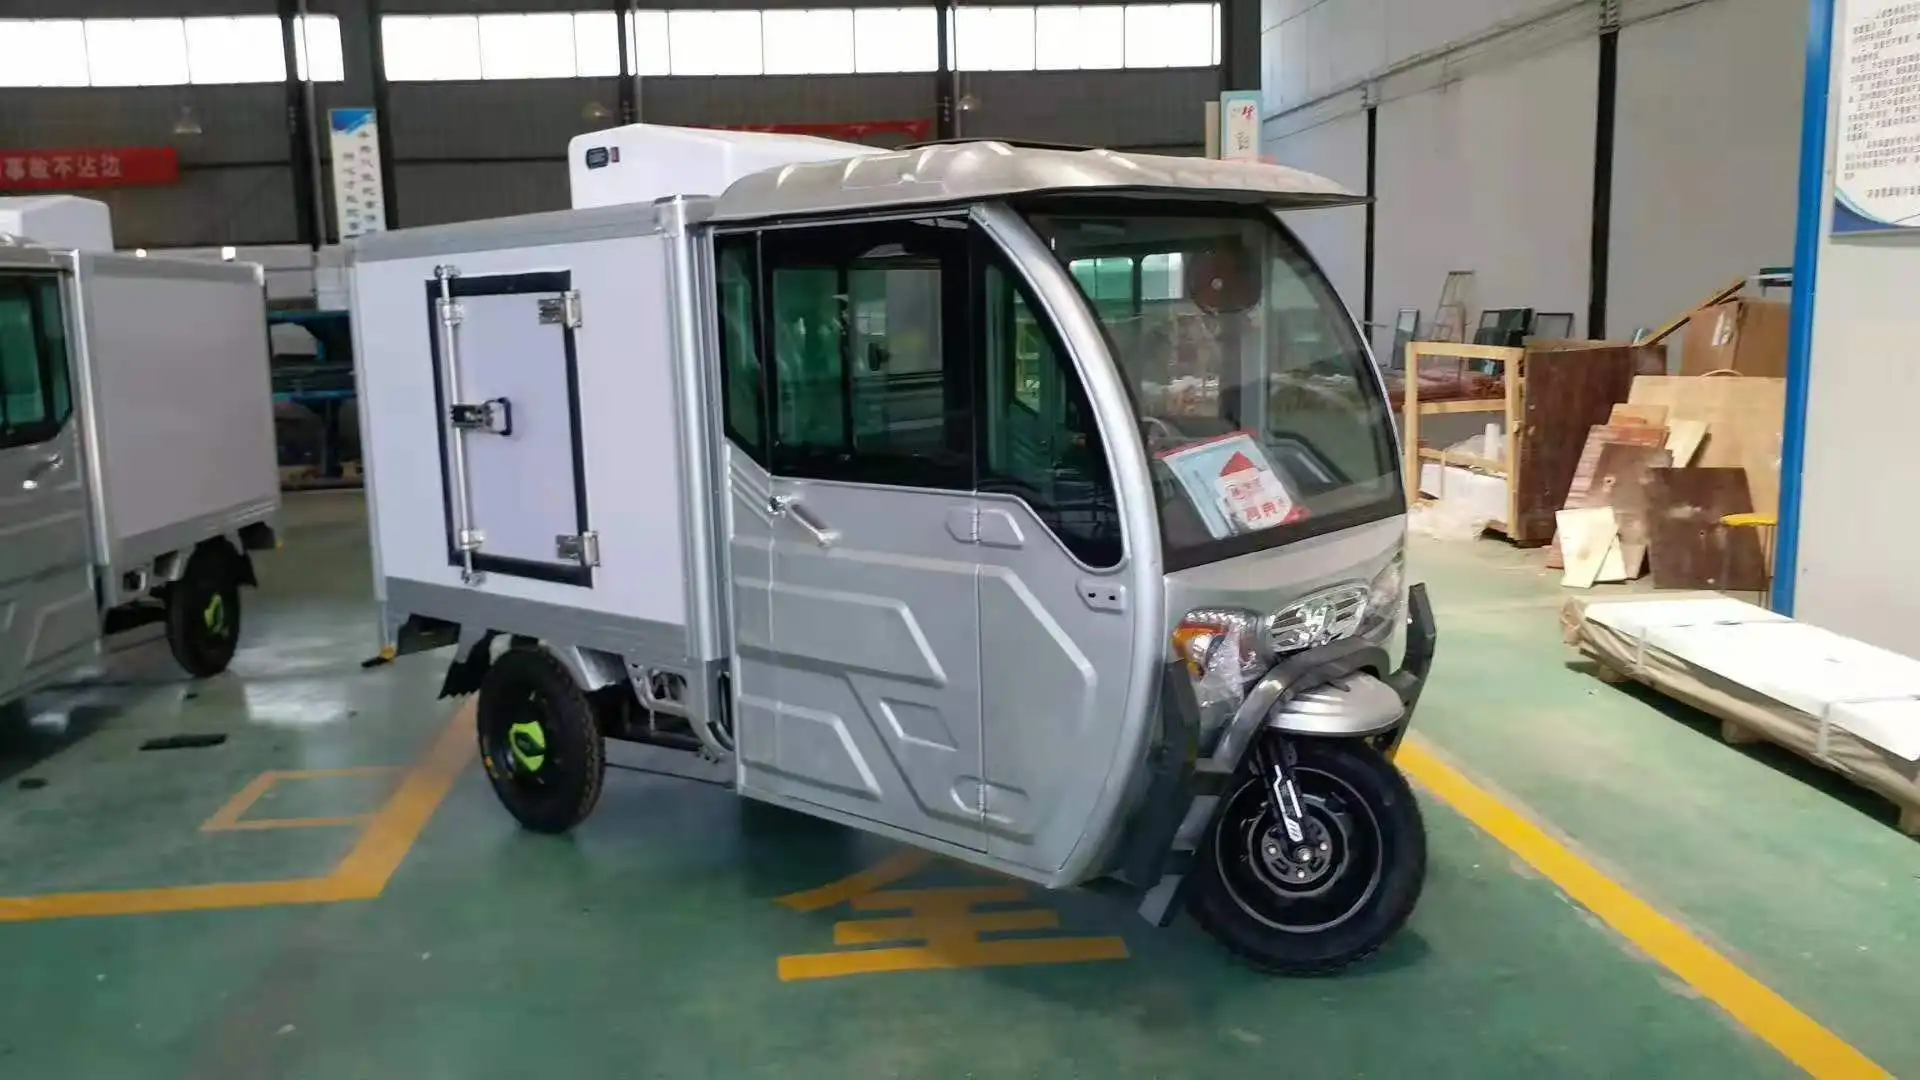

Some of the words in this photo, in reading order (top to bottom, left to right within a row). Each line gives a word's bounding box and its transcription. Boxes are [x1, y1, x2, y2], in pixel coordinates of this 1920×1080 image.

[0, 152, 123, 182] 事故不沾边
